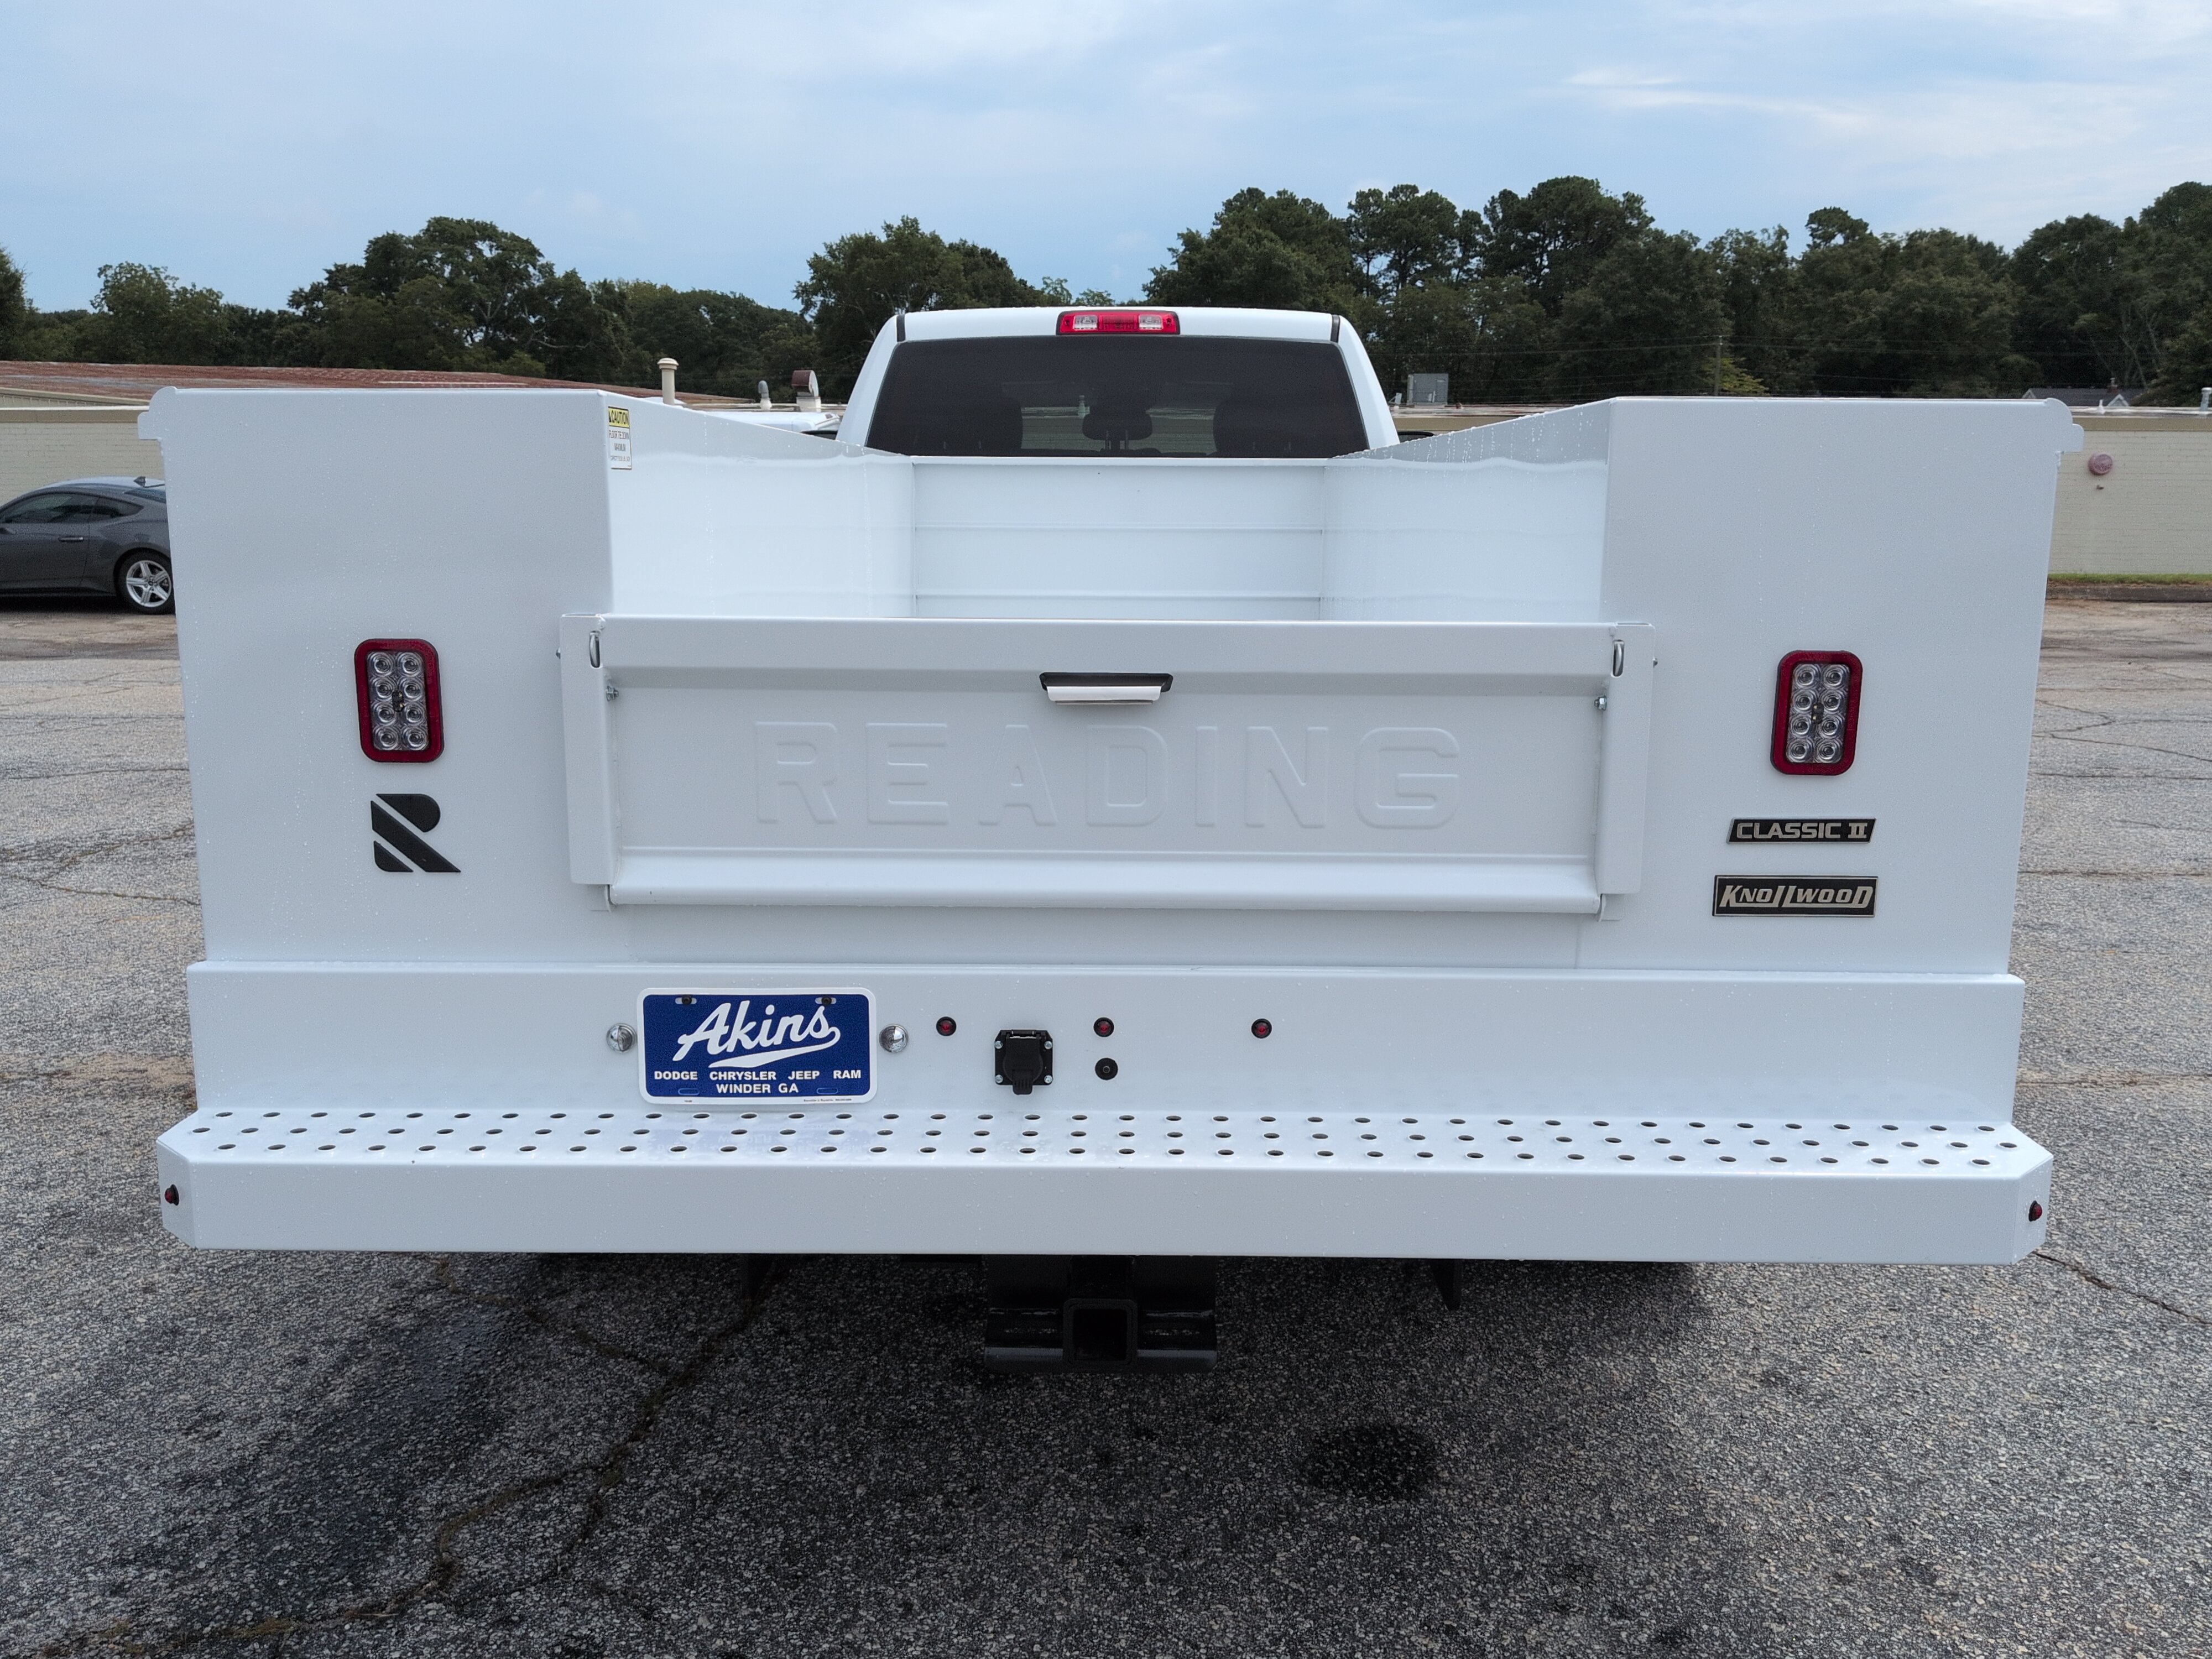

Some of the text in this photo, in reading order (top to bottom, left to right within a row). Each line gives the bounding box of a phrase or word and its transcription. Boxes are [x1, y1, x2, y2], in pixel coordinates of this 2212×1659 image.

[611, 410, 629, 424] CAUTION
[754, 721, 1460, 829] READING
[1736, 822, 1868, 839] CLASSIC II
[1719, 885, 1874, 909] KNOLLWOOD
[672, 999, 841, 1063] Akins
[654, 1070, 862, 1081] DODGE CHRYSLER JEEP RAM
[716, 1083, 799, 1093] WINDER GA
